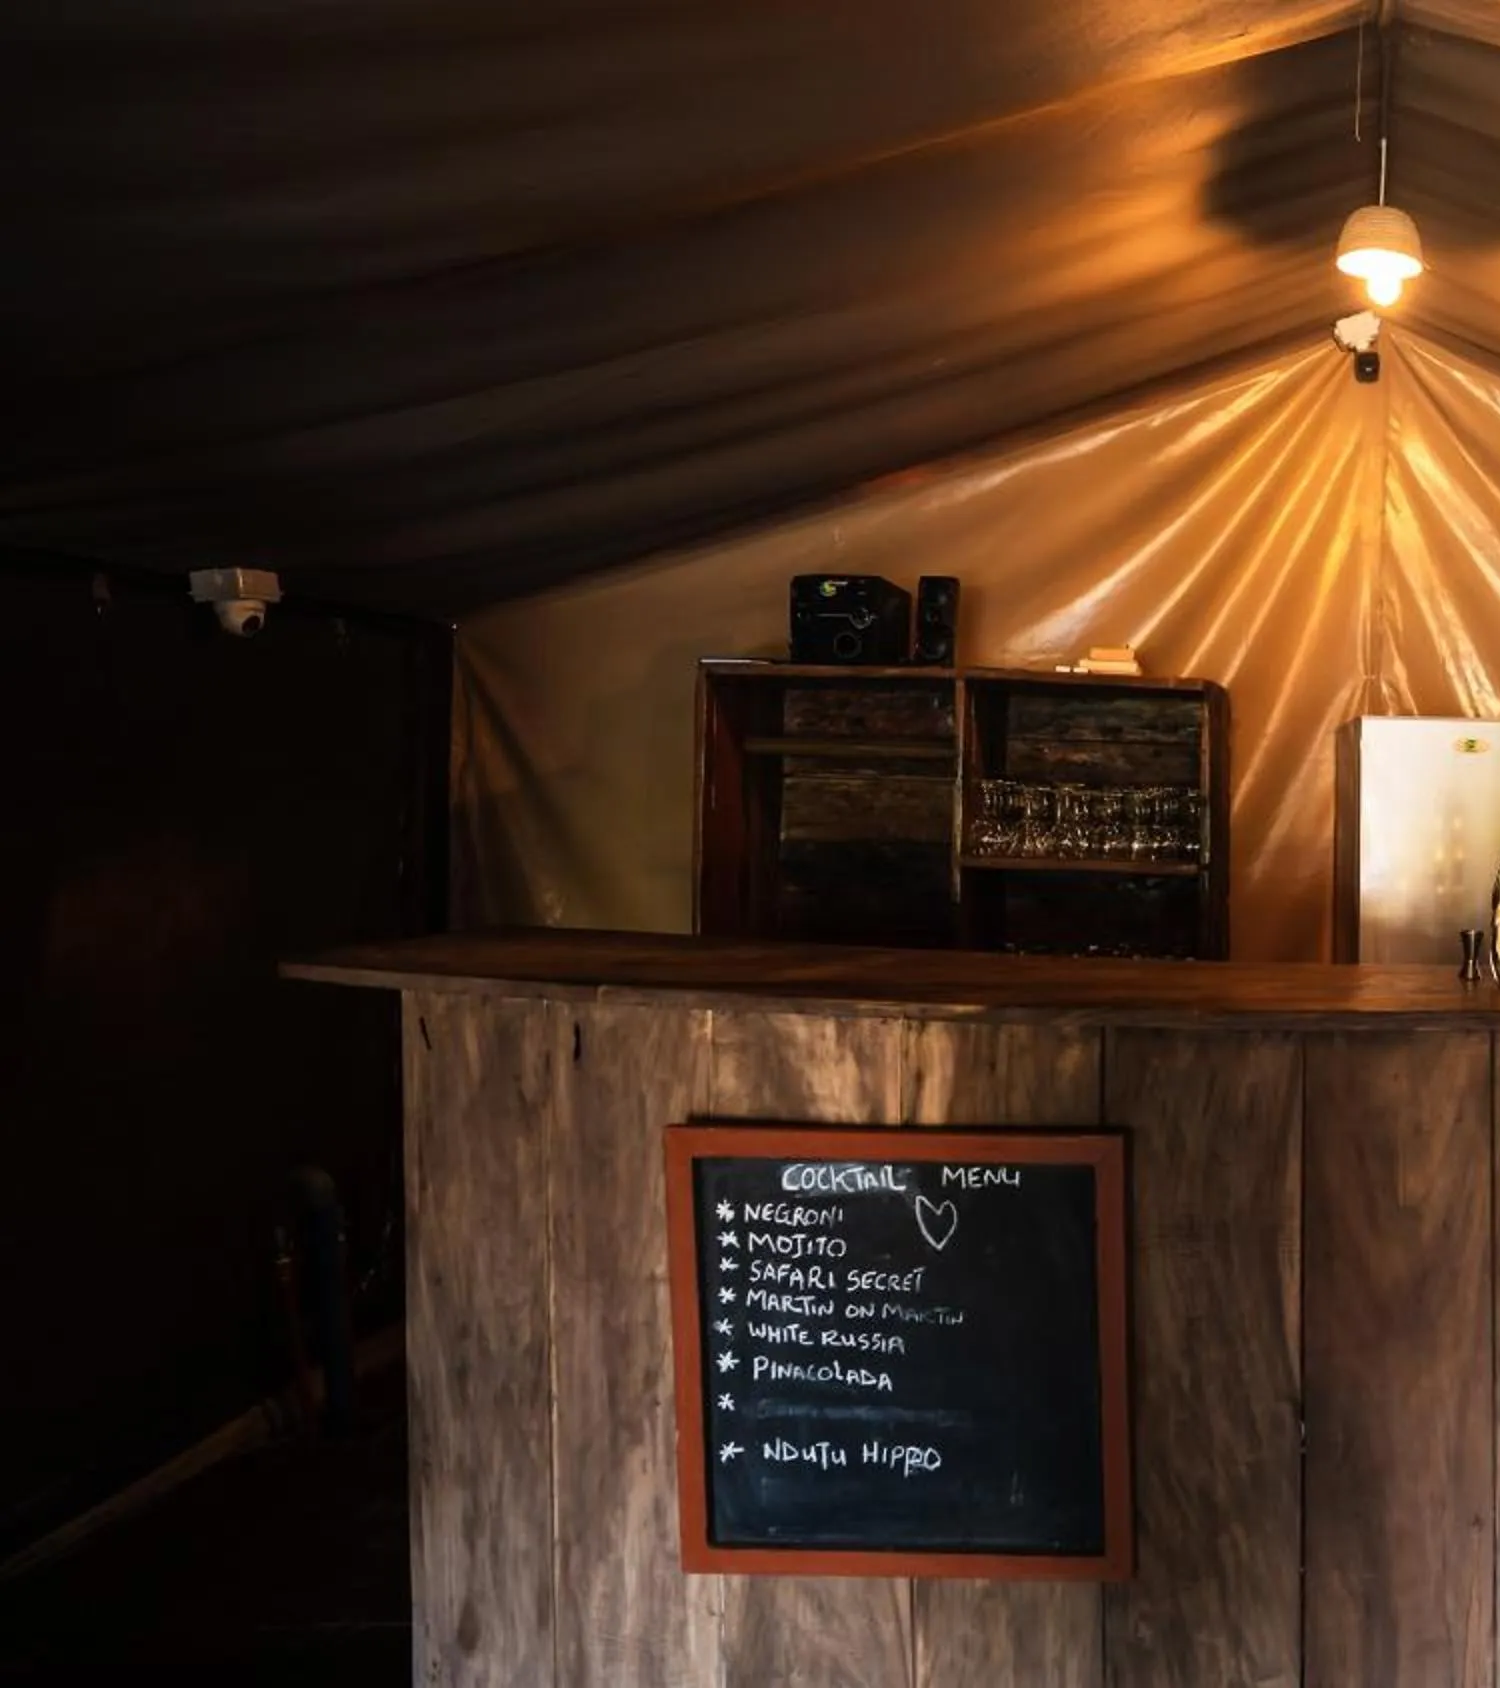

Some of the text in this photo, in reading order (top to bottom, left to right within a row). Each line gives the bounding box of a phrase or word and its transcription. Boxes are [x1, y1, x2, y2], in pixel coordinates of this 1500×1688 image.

[782, 1164, 1020, 1192] COCKTAIL MENU
[744, 1203, 844, 1226] NEGRONI
[748, 1232, 846, 1258] MOJITO
[750, 1260, 926, 1292] SAFARI SECRET
[746, 1289, 834, 1316] MARTIN
[845, 1304, 875, 1318] ON
[748, 1322, 906, 1354] WHITE RUSSIA
[753, 1356, 893, 1391] PINACOLADA
[763, 1437, 847, 1470] NDUTU
